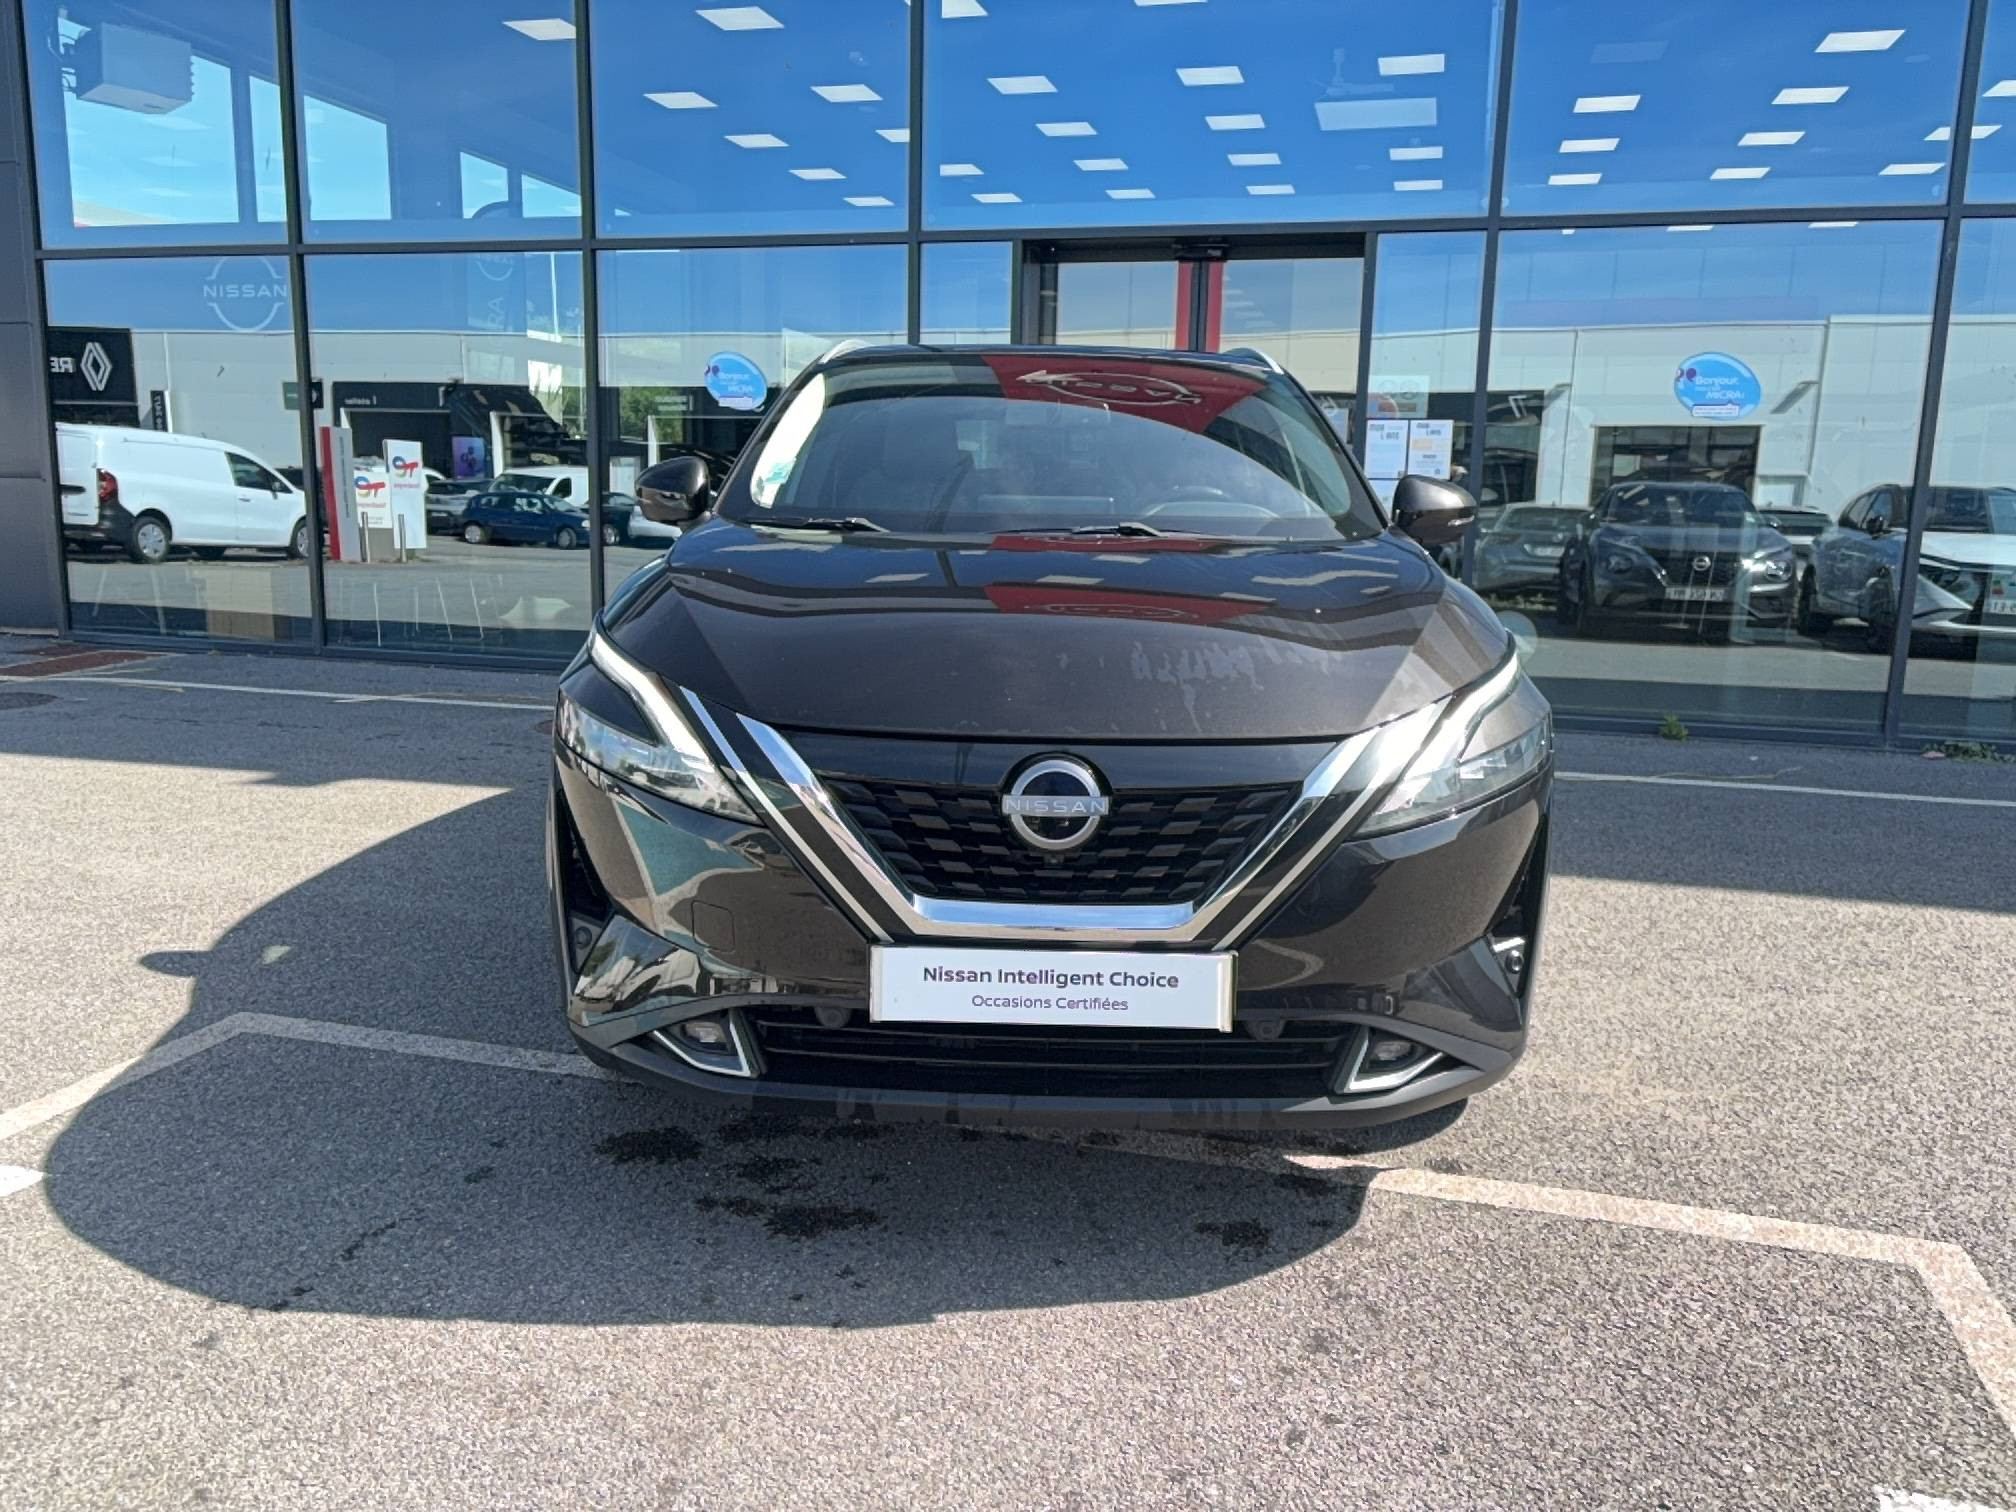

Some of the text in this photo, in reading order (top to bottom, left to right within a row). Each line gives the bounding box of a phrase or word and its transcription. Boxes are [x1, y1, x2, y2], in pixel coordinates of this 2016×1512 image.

[203, 284, 287, 297] NISSAN
[1006, 799, 1106, 813] NISSAN
[923, 966, 1179, 989] Nissan Intelligent Choice
[971, 995, 1129, 1011] Occasions Certifiées
